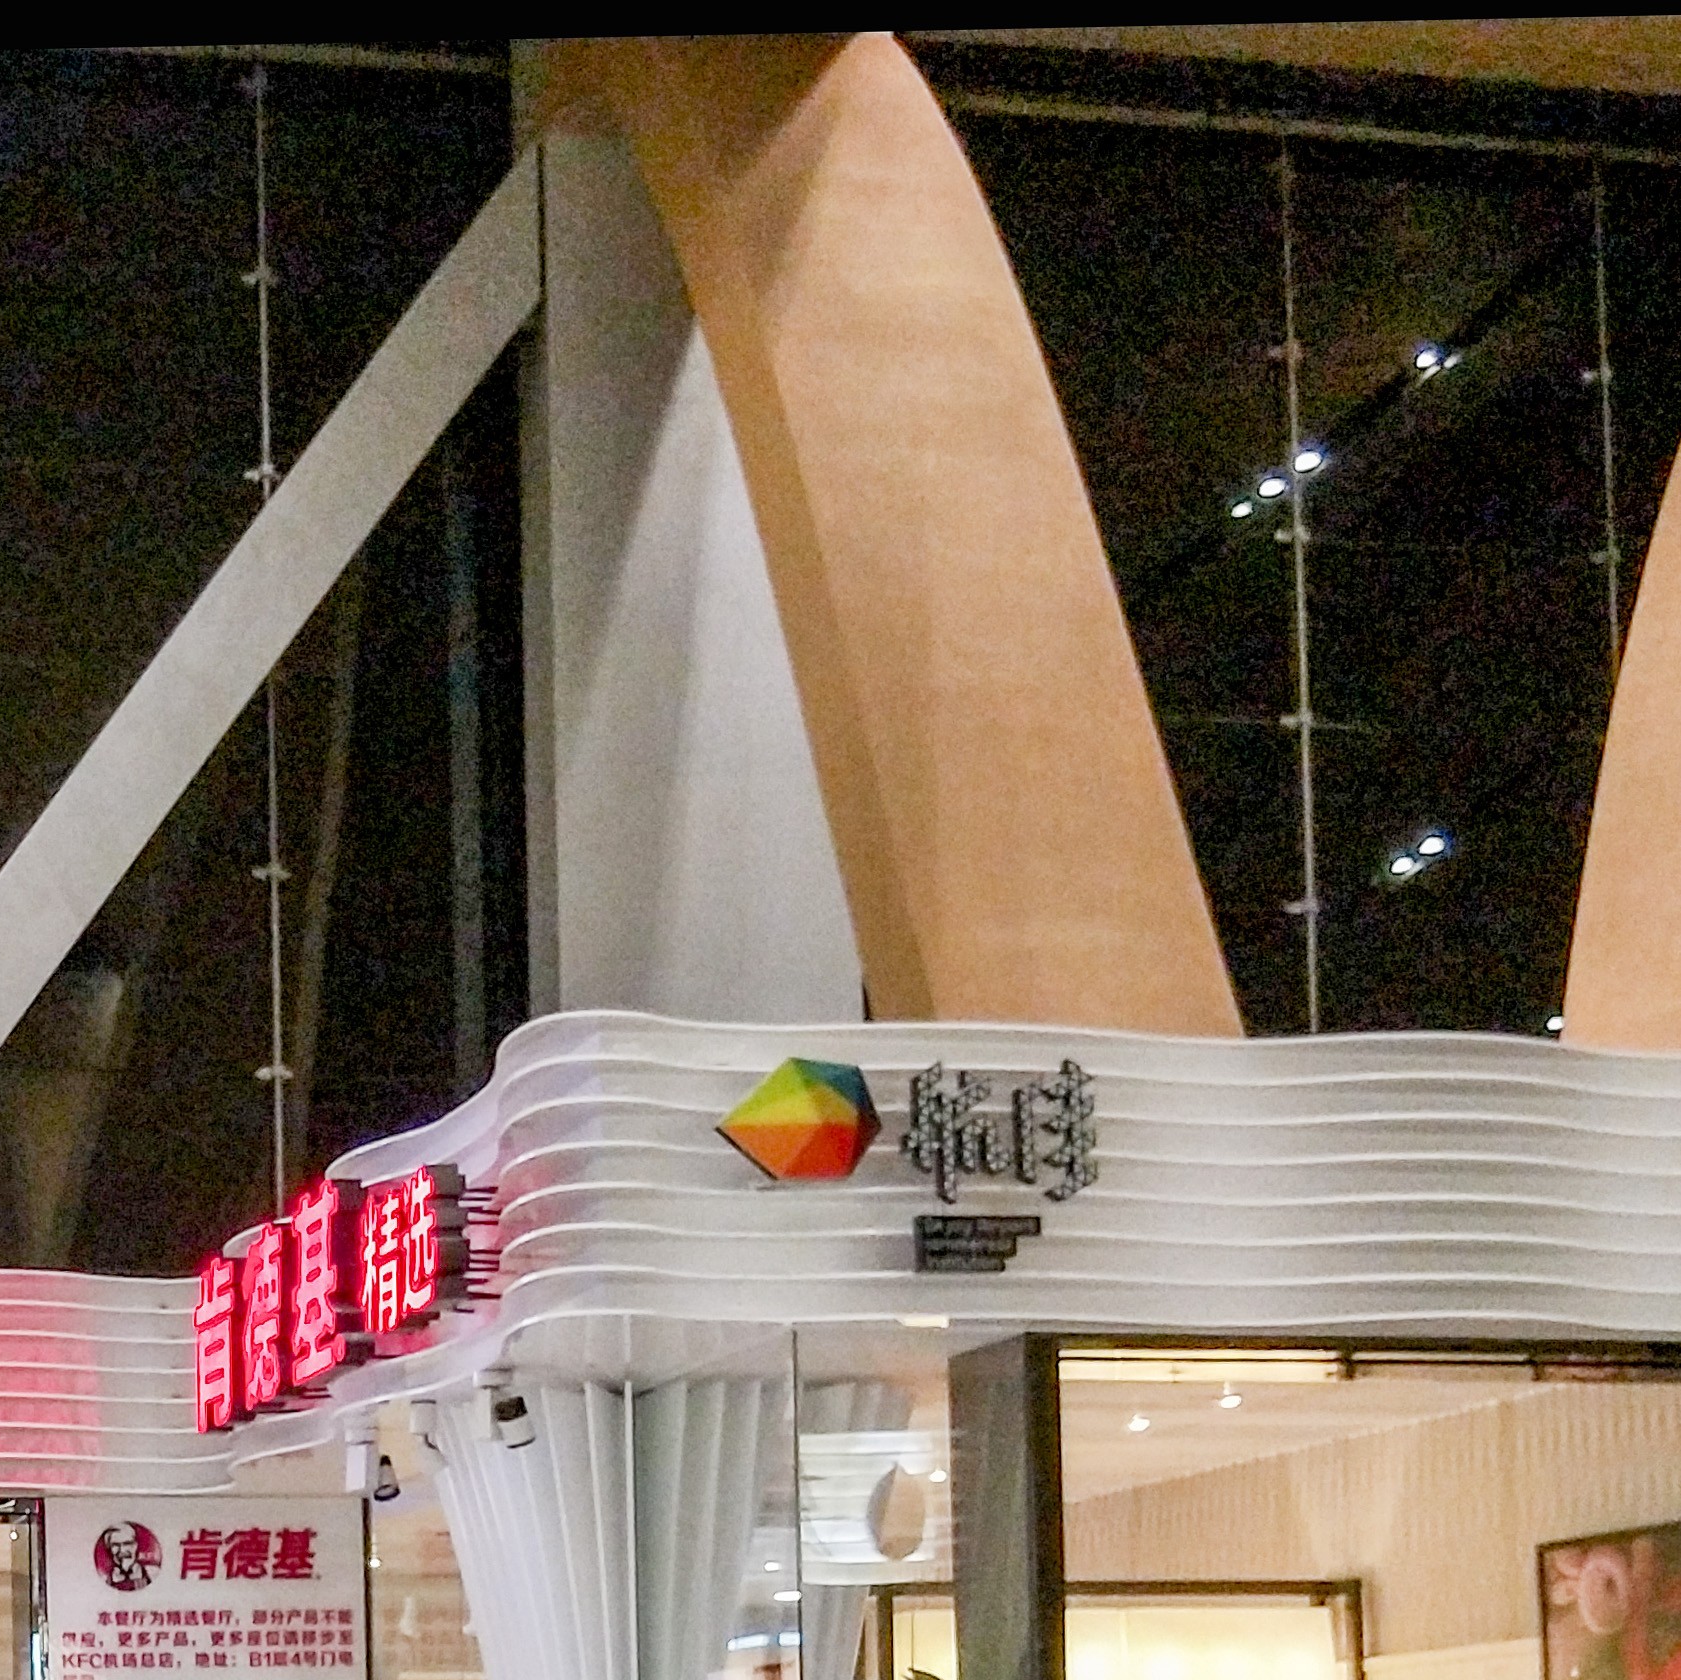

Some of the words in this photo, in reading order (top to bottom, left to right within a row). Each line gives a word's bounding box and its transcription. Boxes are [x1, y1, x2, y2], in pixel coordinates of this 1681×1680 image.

[194, 1179, 338, 1434] 肯德基
[361, 1165, 438, 1334] 精选
[179, 1527, 318, 1580] 肯德基
